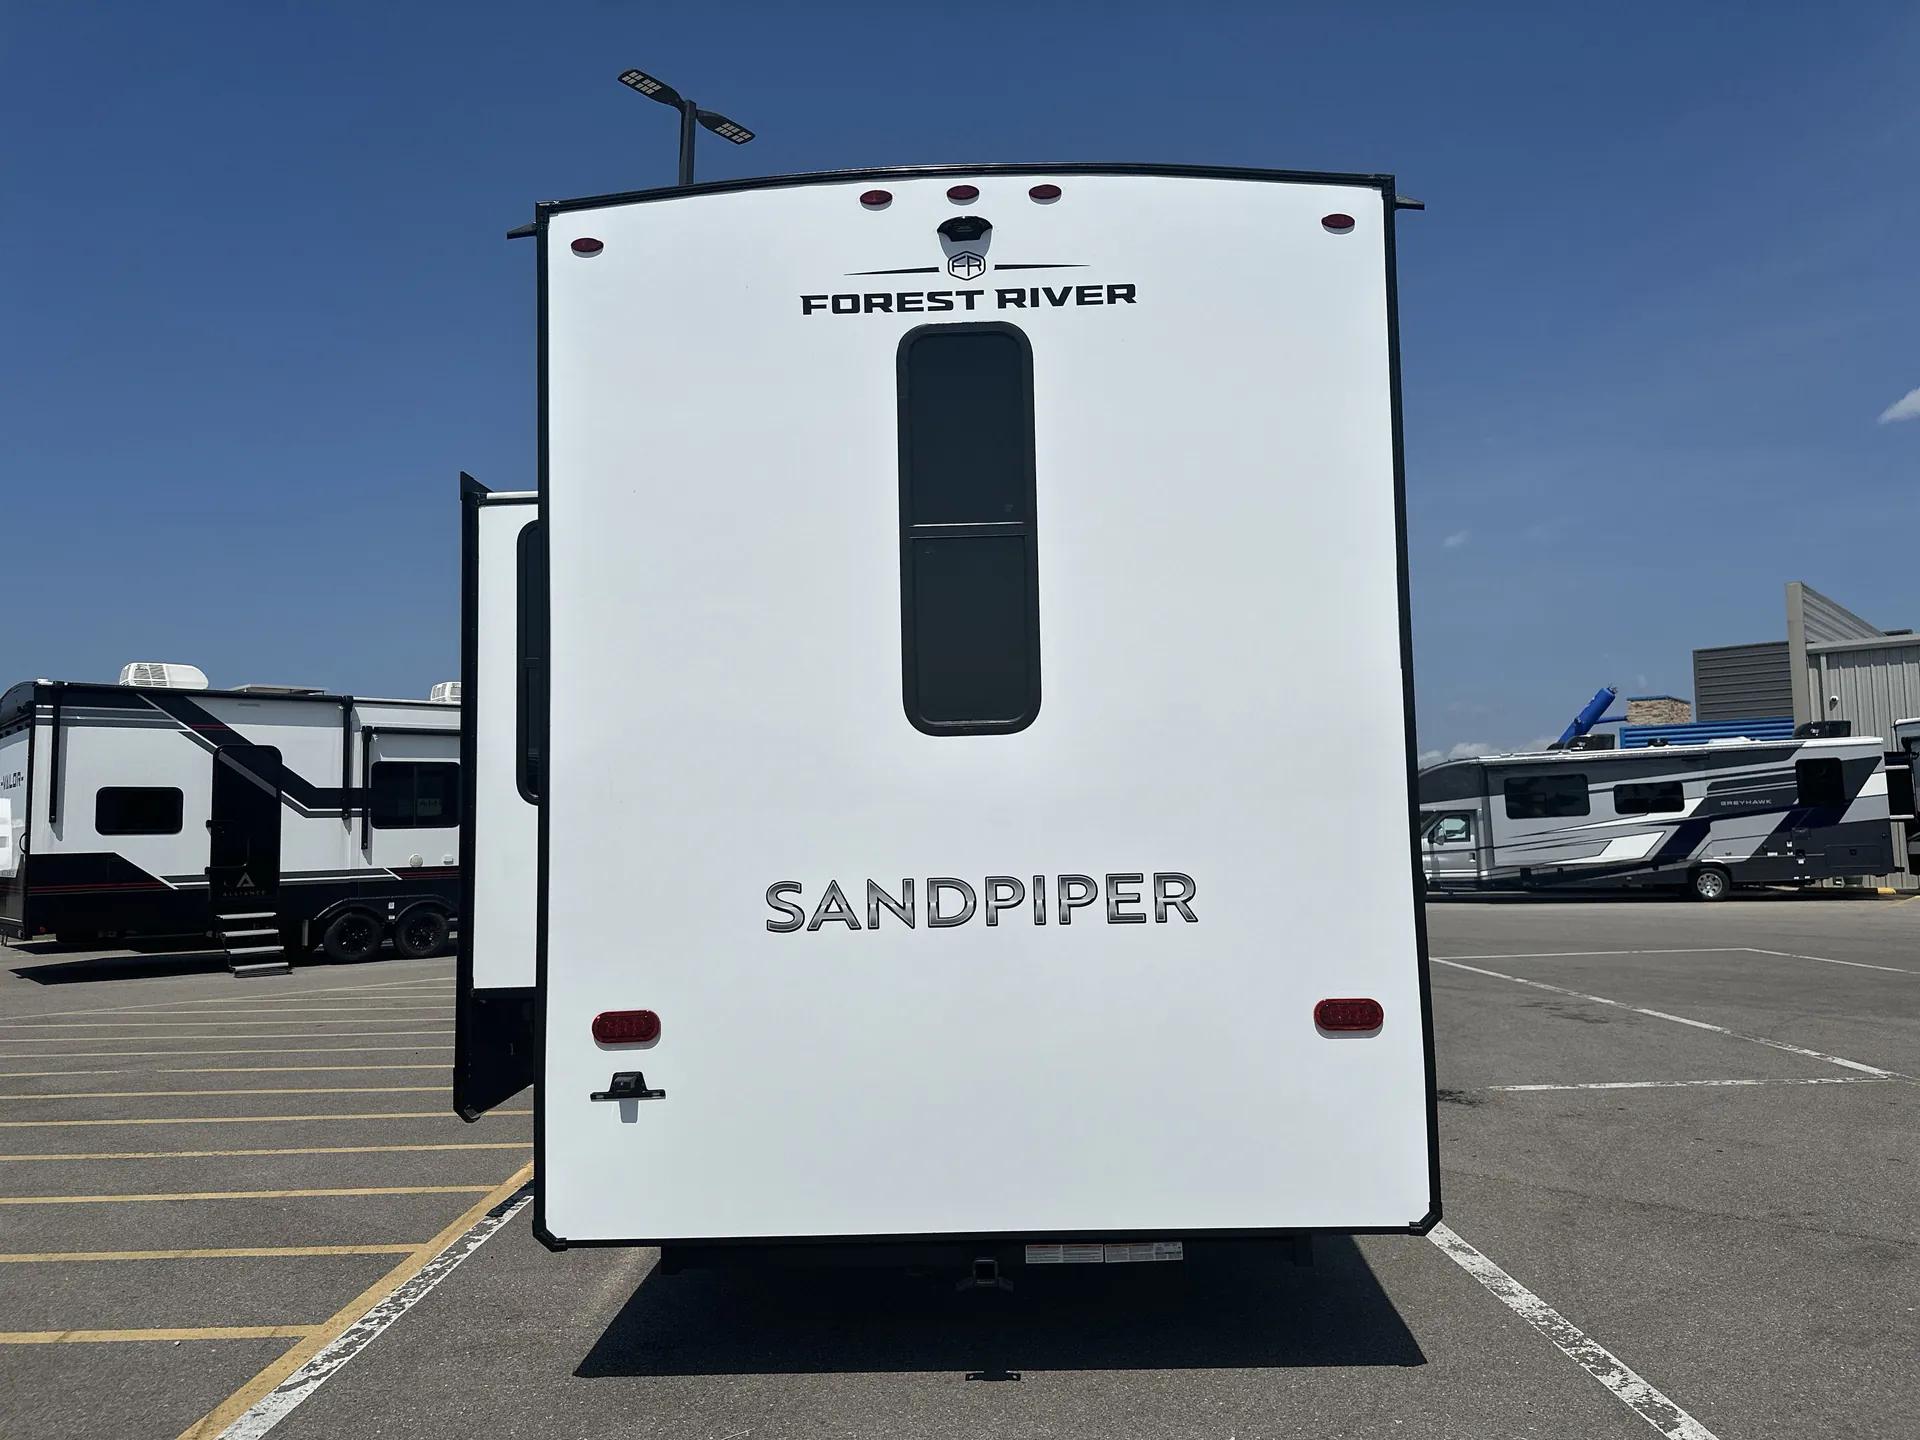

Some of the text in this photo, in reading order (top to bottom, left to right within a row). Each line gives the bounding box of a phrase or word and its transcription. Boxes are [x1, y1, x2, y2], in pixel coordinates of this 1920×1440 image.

[800, 284, 1136, 315] FOREST RIVER
[766, 872, 1198, 933] SANDPIPER
